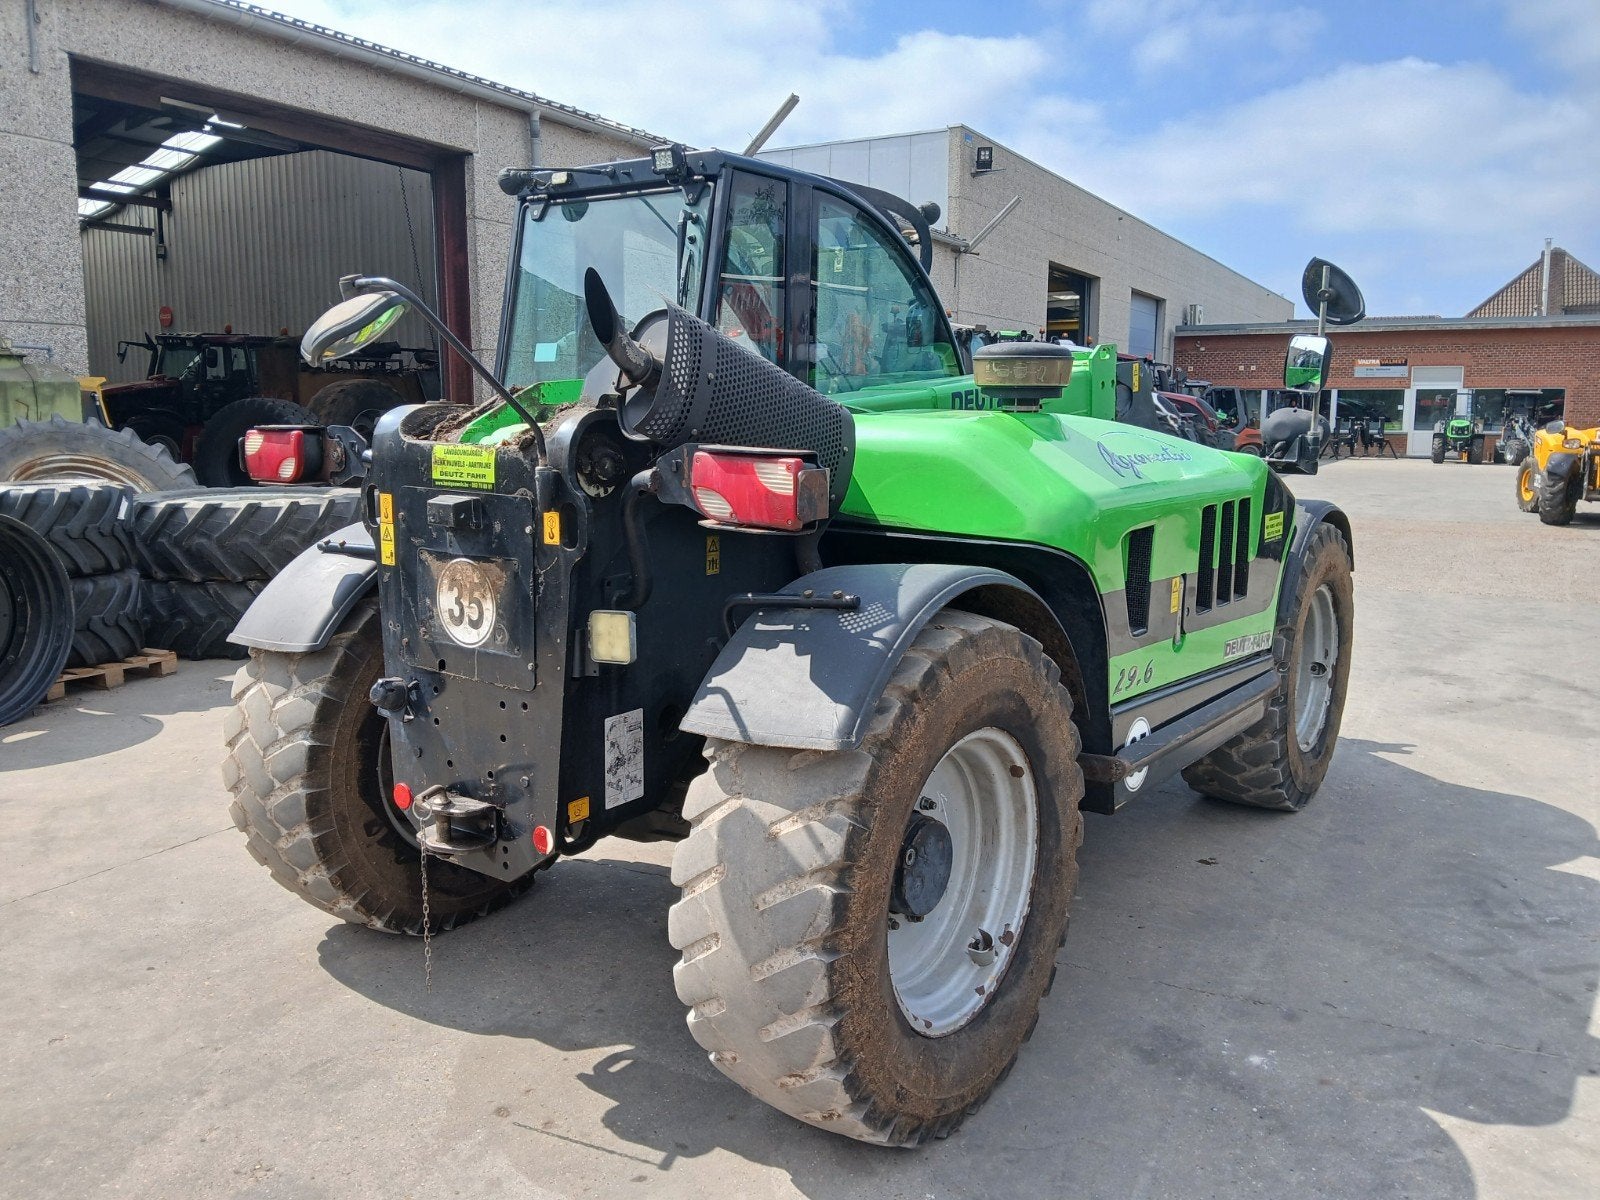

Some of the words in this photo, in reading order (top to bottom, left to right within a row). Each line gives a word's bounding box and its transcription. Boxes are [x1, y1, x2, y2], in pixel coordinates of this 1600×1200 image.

[440, 470, 464, 479] DEUTZ
[467, 472, 487, 480] FAHR
[447, 577, 485, 630] 35
[1112, 658, 1154, 696] 29.6
